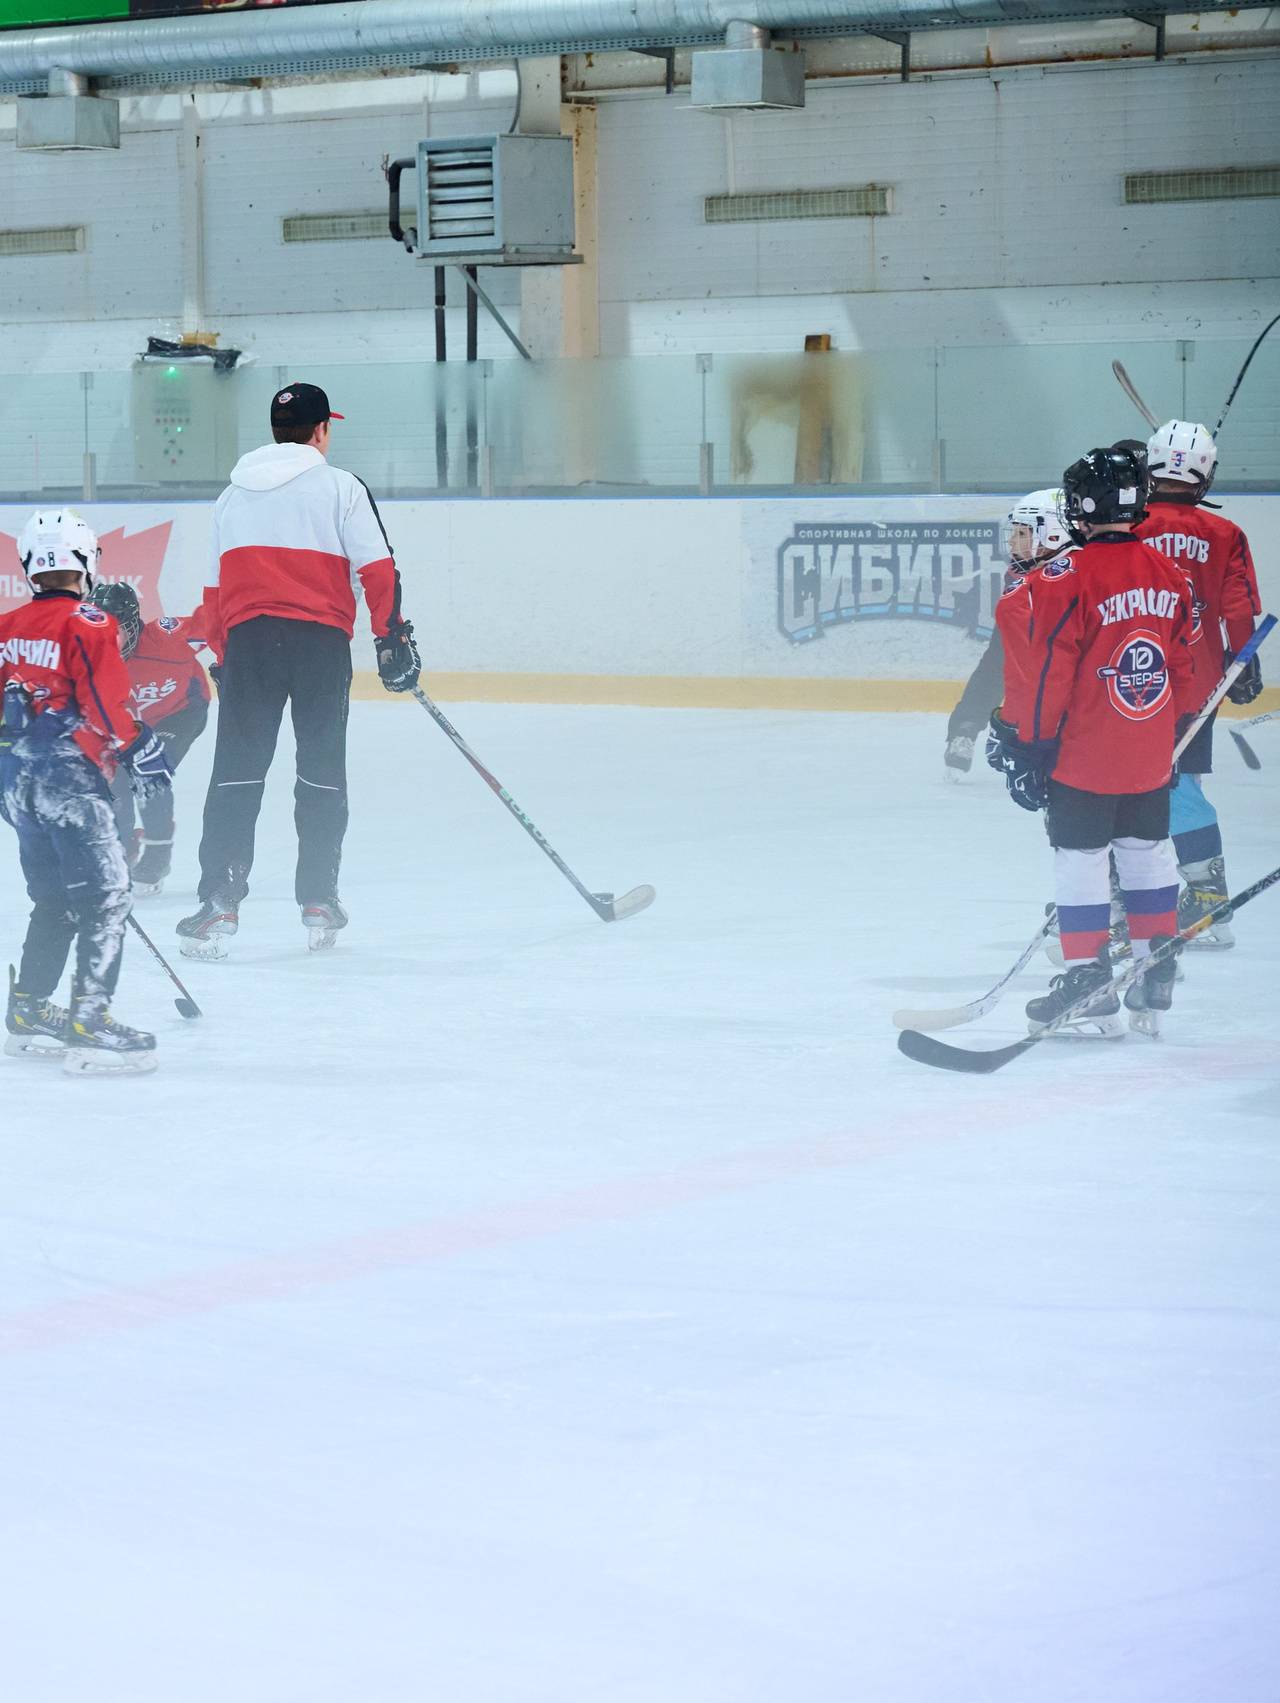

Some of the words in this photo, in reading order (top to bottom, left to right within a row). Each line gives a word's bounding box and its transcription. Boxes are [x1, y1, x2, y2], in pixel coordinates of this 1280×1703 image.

[1174, 453, 1182, 467] 3
[798, 529, 871, 539] СПОРТИВНАЯ
[878, 529, 918, 538] ШКОЛА
[924, 529, 939, 538] ПО
[945, 529, 994, 538] ХОККЕЮ
[47, 551, 56, 568] 8
[783, 543, 1005, 633] СИБИРЬ
[1129, 646, 1154, 671] 10
[1120, 671, 1165, 687] STEPS
